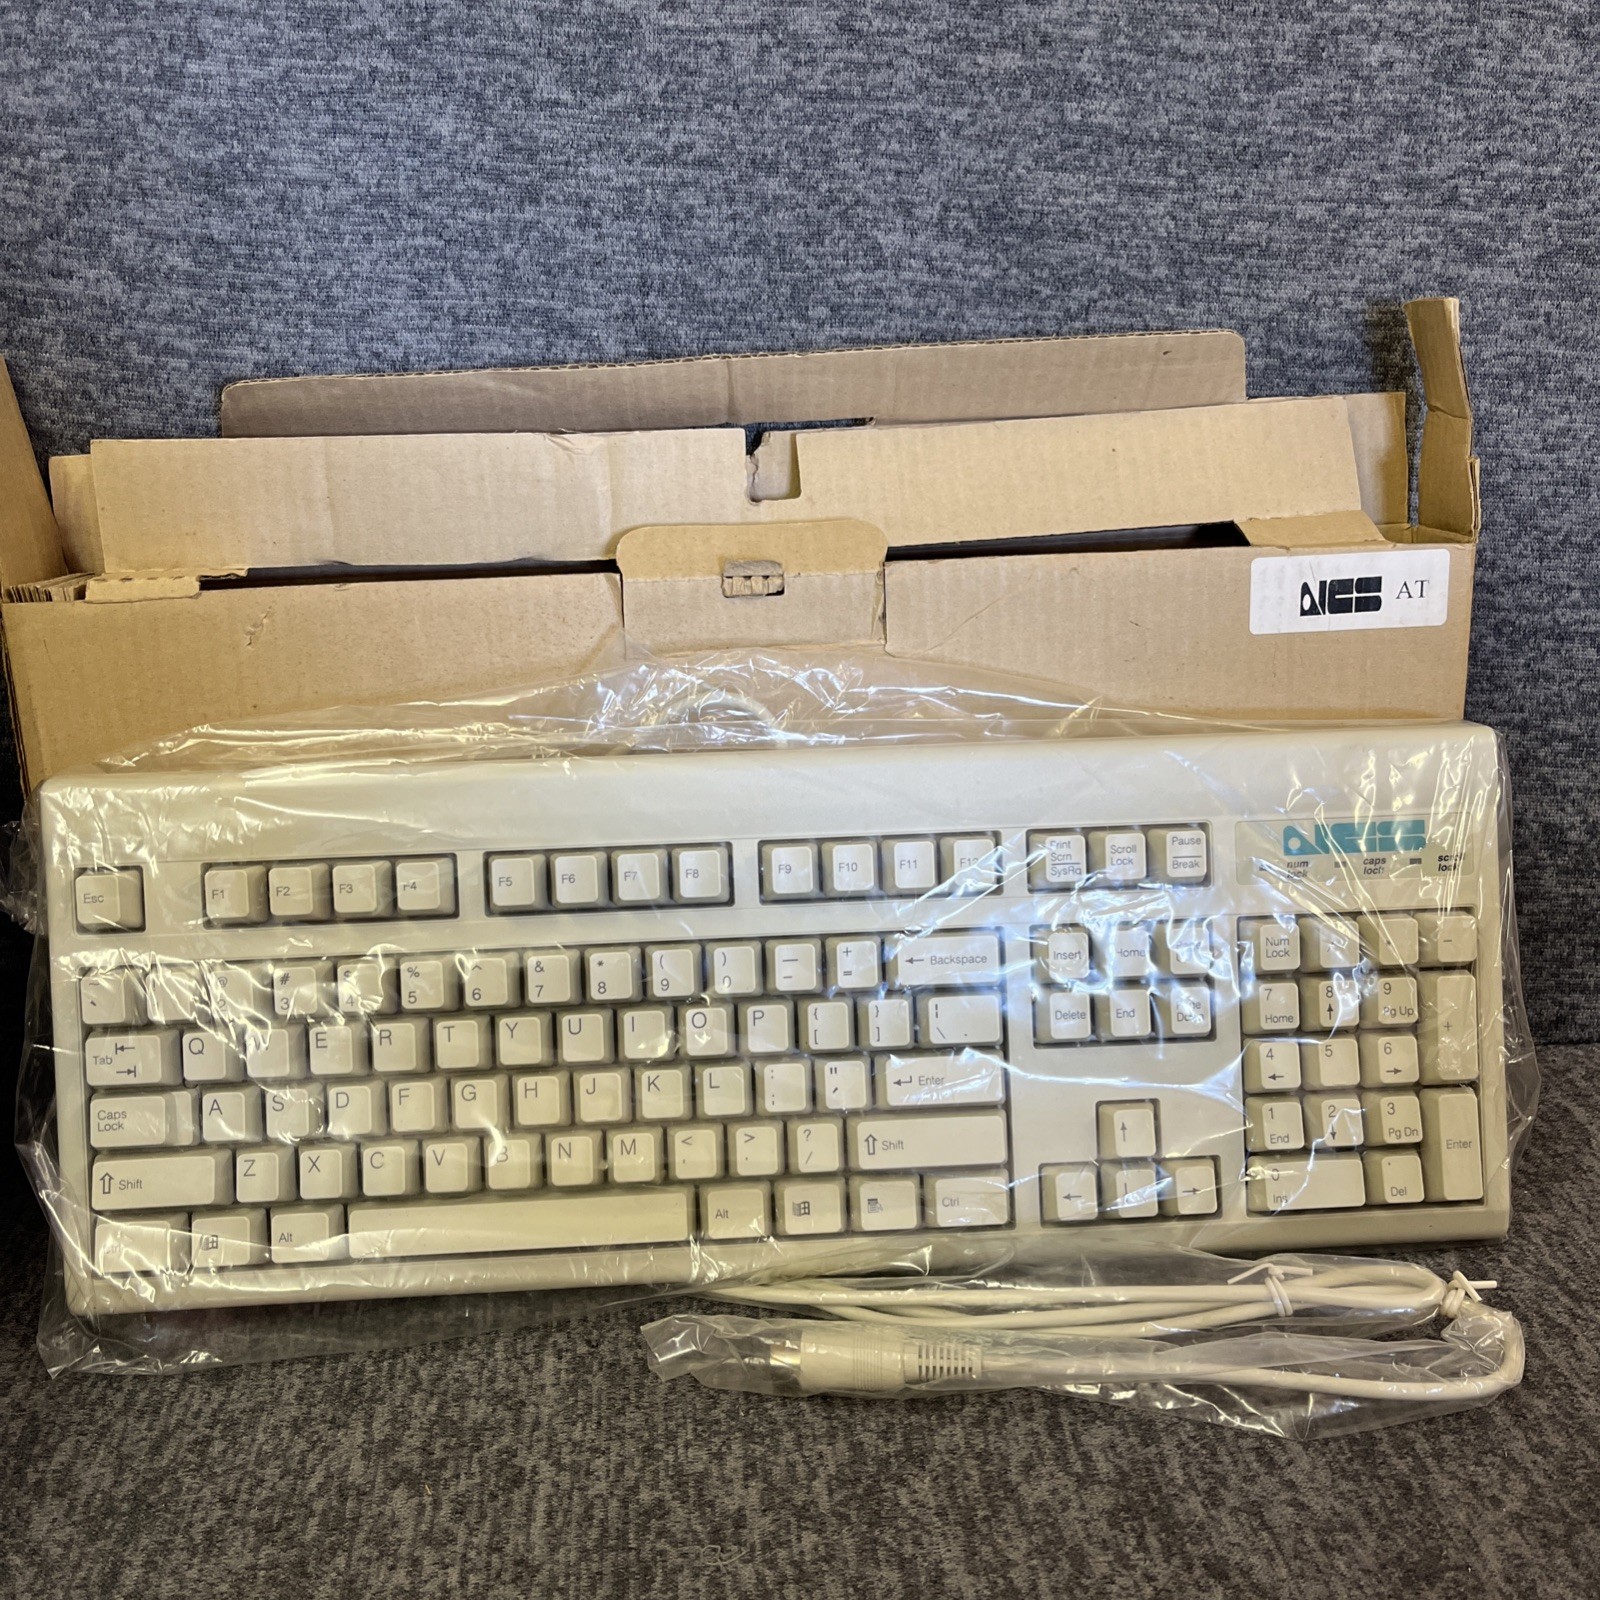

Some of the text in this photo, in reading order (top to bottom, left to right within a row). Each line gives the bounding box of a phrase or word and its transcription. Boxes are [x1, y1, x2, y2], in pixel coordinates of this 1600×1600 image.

[1396, 580, 1430, 600] AT
[1171, 836, 1202, 847] Pause
[1110, 844, 1137, 856] Scroll
[1051, 852, 1072, 862] Scrn
[1111, 856, 1134, 866] Lock
[1363, 857, 1387, 867] caps
[778, 864, 792, 875] F9
[838, 862, 858, 873] F10
[900, 859, 918, 870] F11
[1172, 859, 1201, 870] Break
[1287, 860, 1309, 869] num
[561, 874, 576, 885] F6
[624, 871, 638, 882] F7
[685, 868, 700, 879] F8
[498, 877, 513, 887] F5
[212, 889, 226, 900] F1
[276, 887, 291, 897] F2
[339, 884, 354, 895] F3
[83, 893, 105, 905] Esc
[1265, 937, 1290, 947] Num
[842, 947, 853, 957] +
[1053, 950, 1082, 961] Insert
[1265, 948, 1291, 959] Lock
[659, 954, 665, 970] (
[722, 952, 728, 967] )
[930, 954, 988, 967] Backspace
[407, 966, 421, 978] %
[534, 961, 546, 973] &
[217, 977, 228, 989] @
[280, 973, 291, 985] #
[660, 978, 670, 992] 9
[472, 987, 482, 1001] 6
[535, 985, 544, 998] 7
[597, 981, 607, 995] 8
[1264, 988, 1273, 1001] 7
[1326, 986, 1334, 999] 8
[1383, 983, 1392, 996] 9
[345, 994, 355, 1007] 4
[407, 991, 418, 1004] 5
[217, 999, 228, 1012] 2
[280, 998, 291, 1011] 3
[753, 1010, 765, 1027] P
[1055, 1010, 1087, 1021] Delete
[1116, 1009, 1136, 1019] End
[1265, 1013, 1295, 1024] Home
[1384, 1006, 1415, 1019] Pg Up
[568, 1018, 583, 1036] U
[691, 1012, 708, 1029] O
[443, 1025, 456, 1043] T
[505, 1022, 519, 1039] Y
[876, 1027, 881, 1042] ]
[315, 1031, 328, 1049] E
[379, 1029, 393, 1047] R
[814, 1030, 820, 1045] [
[188, 1037, 205, 1055] Q
[1325, 1045, 1333, 1058] 5
[1383, 1042, 1393, 1055] 6
[93, 1055, 113, 1066] Tab
[1266, 1048, 1274, 1061] 4
[586, 1078, 597, 1096] J
[647, 1075, 661, 1093] K
[709, 1072, 721, 1090] L
[918, 1075, 945, 1087] Enter
[461, 1084, 477, 1102] G
[524, 1081, 539, 1099] H
[272, 1095, 285, 1112] S
[335, 1092, 350, 1109] D
[398, 1088, 411, 1106] F
[209, 1099, 223, 1117] A
[1269, 1107, 1275, 1120] 1
[1328, 1105, 1337, 1118] 2
[1387, 1102, 1396, 1116] 3
[97, 1109, 127, 1122] Caps
[97, 1121, 125, 1133] Lock
[1388, 1126, 1419, 1139] Pg Dn
[681, 1135, 694, 1147] <
[743, 1133, 756, 1144] >
[803, 1129, 812, 1142] ?
[1270, 1134, 1290, 1145] End
[558, 1142, 573, 1160] N
[620, 1138, 637, 1156] M
[881, 1140, 905, 1151] Shift
[1446, 1139, 1473, 1150] Enter
[370, 1152, 385, 1170] C
[432, 1149, 446, 1167] V
[805, 1151, 813, 1165] /
[243, 1159, 257, 1177] Z
[307, 1156, 321, 1174] X
[1272, 1168, 1280, 1182] 0
[118, 1179, 143, 1191] Shift
[1391, 1186, 1408, 1197] Del
[941, 1196, 960, 1208] Ctrl
[1273, 1194, 1289, 1204] Ins
[715, 1208, 729, 1220] Alt
[279, 1232, 293, 1244] Alt
